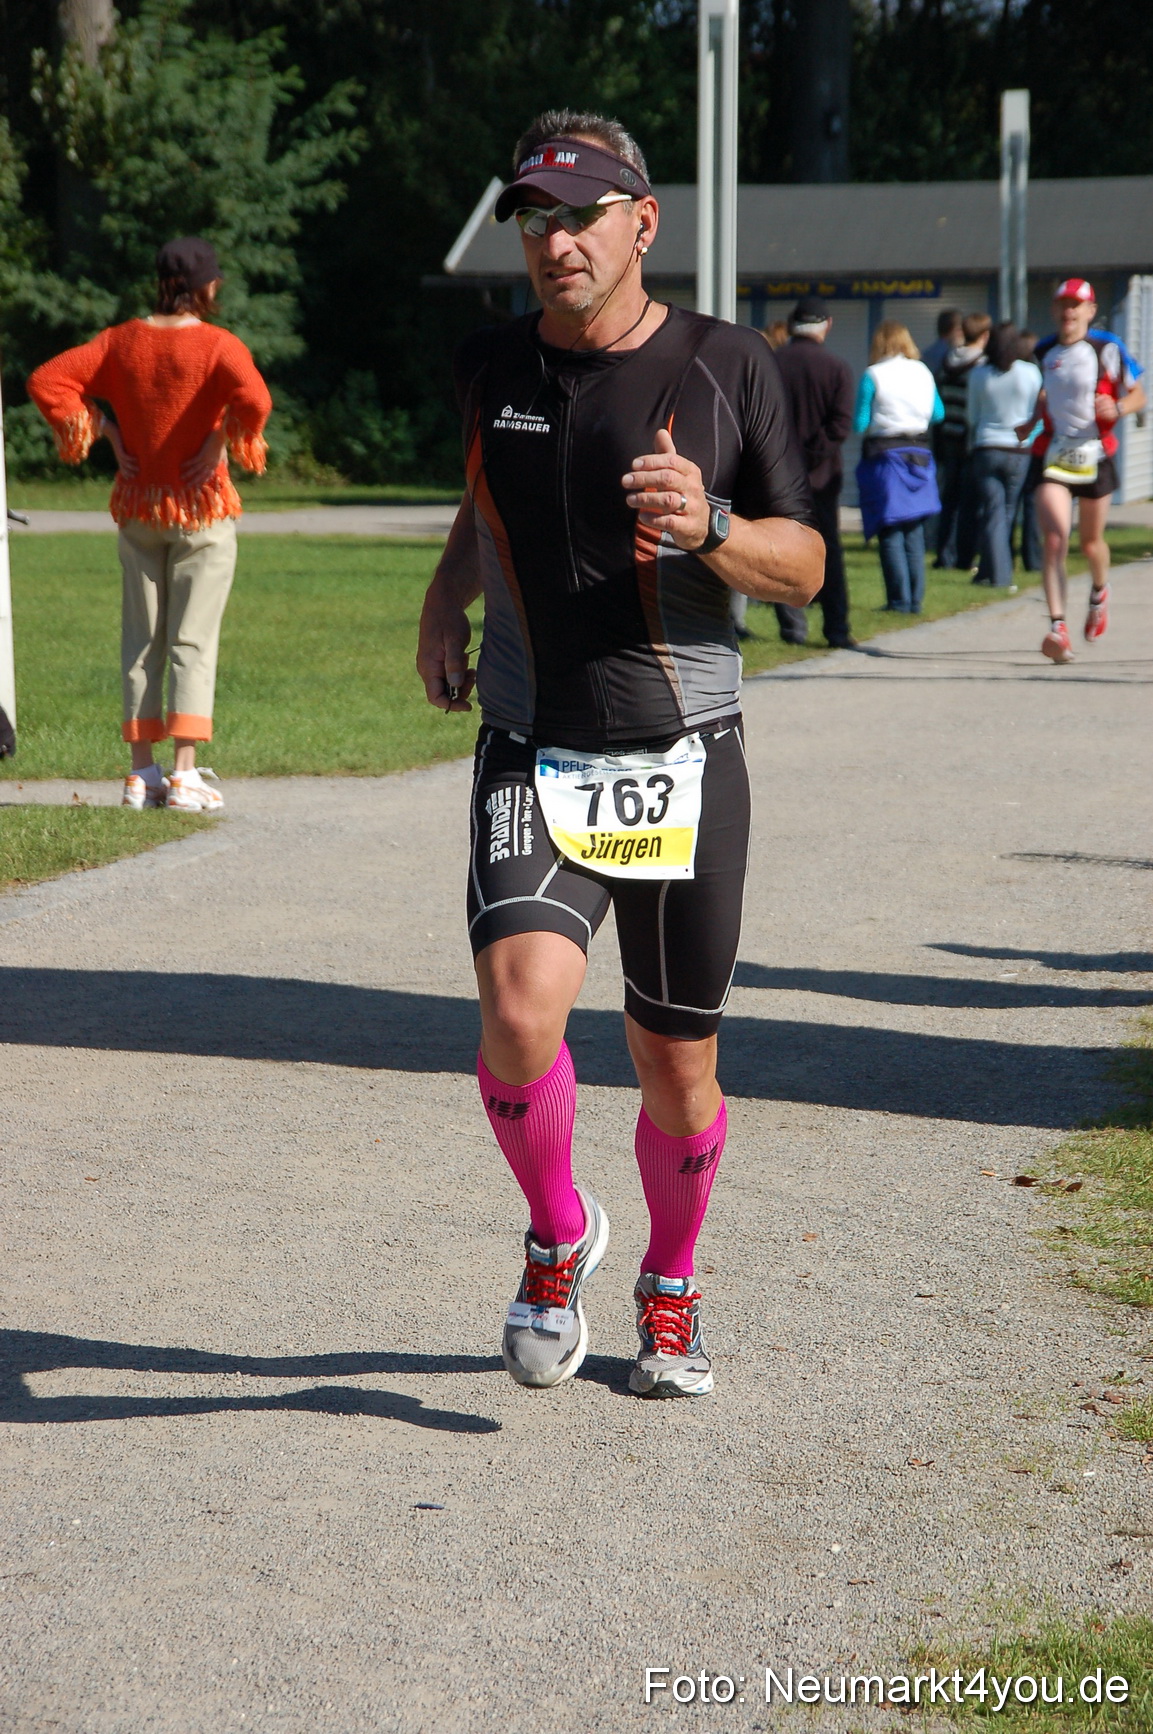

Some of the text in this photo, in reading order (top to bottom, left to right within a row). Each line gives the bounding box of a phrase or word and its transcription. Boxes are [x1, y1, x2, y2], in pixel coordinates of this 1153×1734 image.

[493, 419, 550, 433] RAMSAUER
[574, 774, 675, 827] 763
[581, 833, 662, 865] Jürgen
